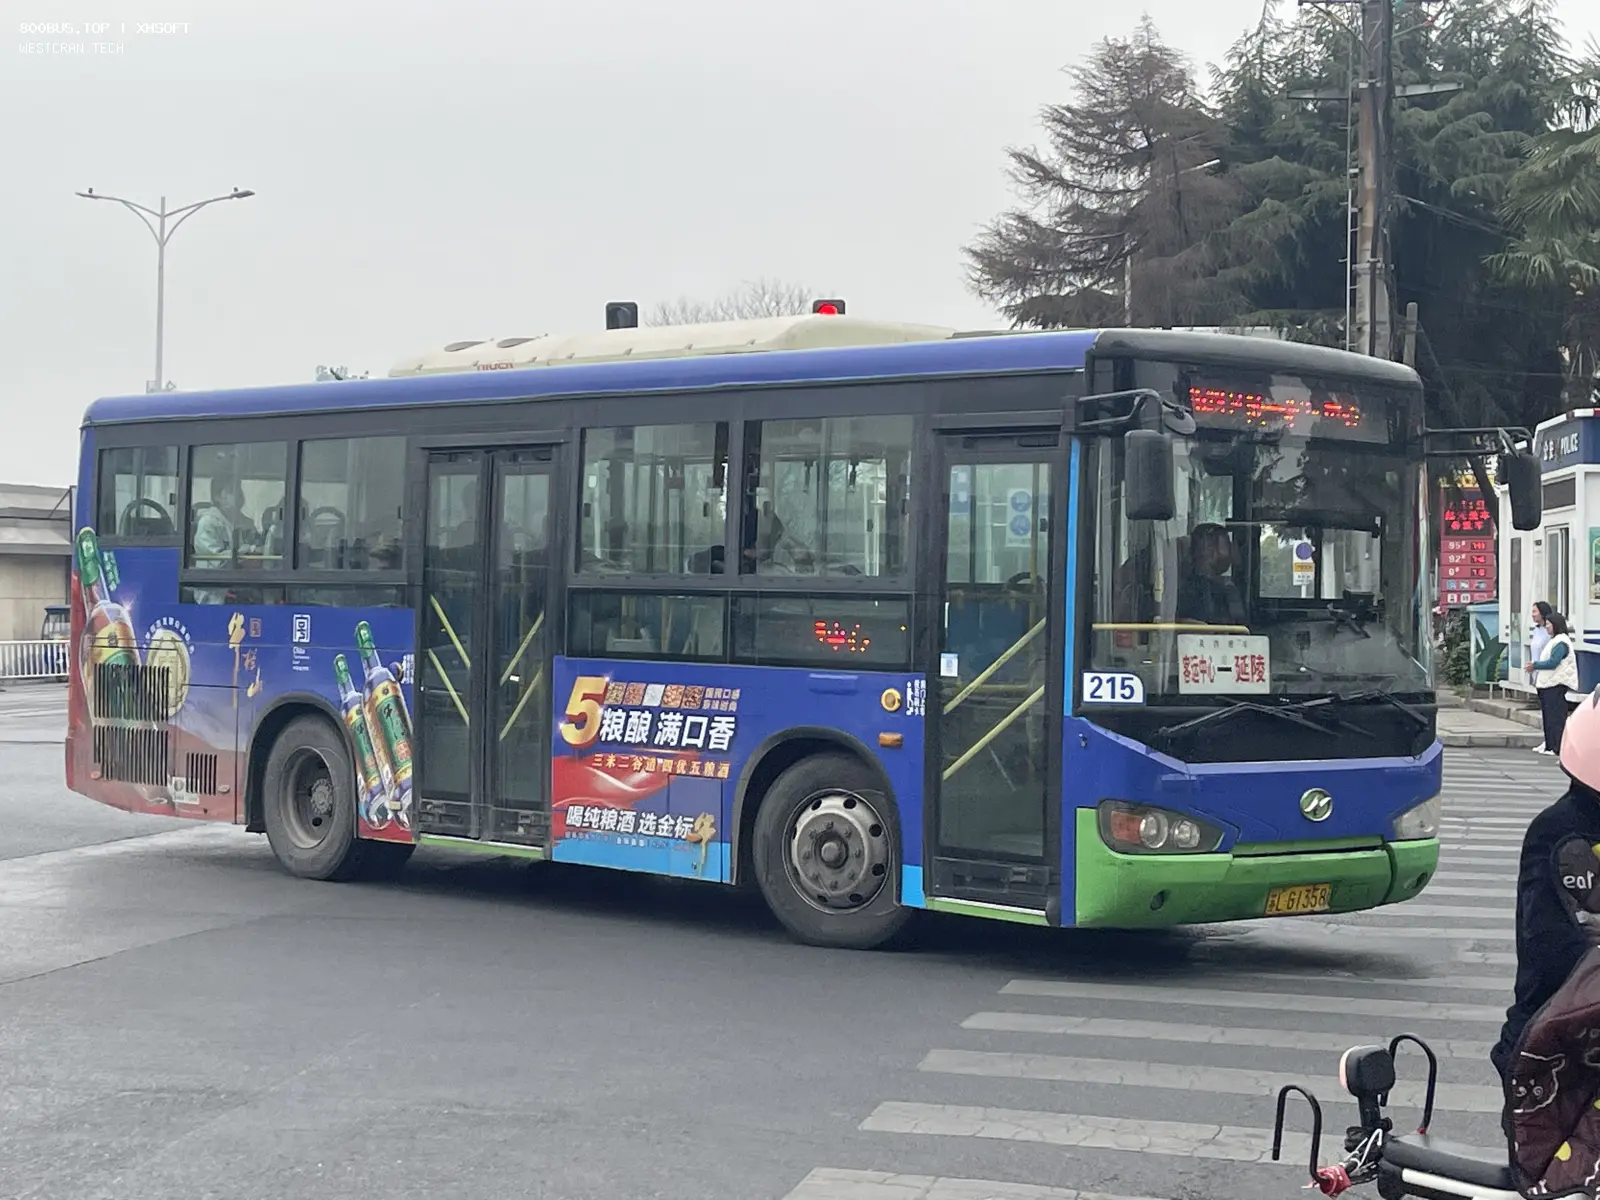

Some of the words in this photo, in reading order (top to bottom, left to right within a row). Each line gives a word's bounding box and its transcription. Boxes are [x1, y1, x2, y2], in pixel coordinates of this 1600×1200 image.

[1089, 675, 1136, 700] 215
[654, 711, 736, 751] 满口香
[566, 805, 637, 833] 喝纯粮酒
[1563, 870, 1595, 889] eat
